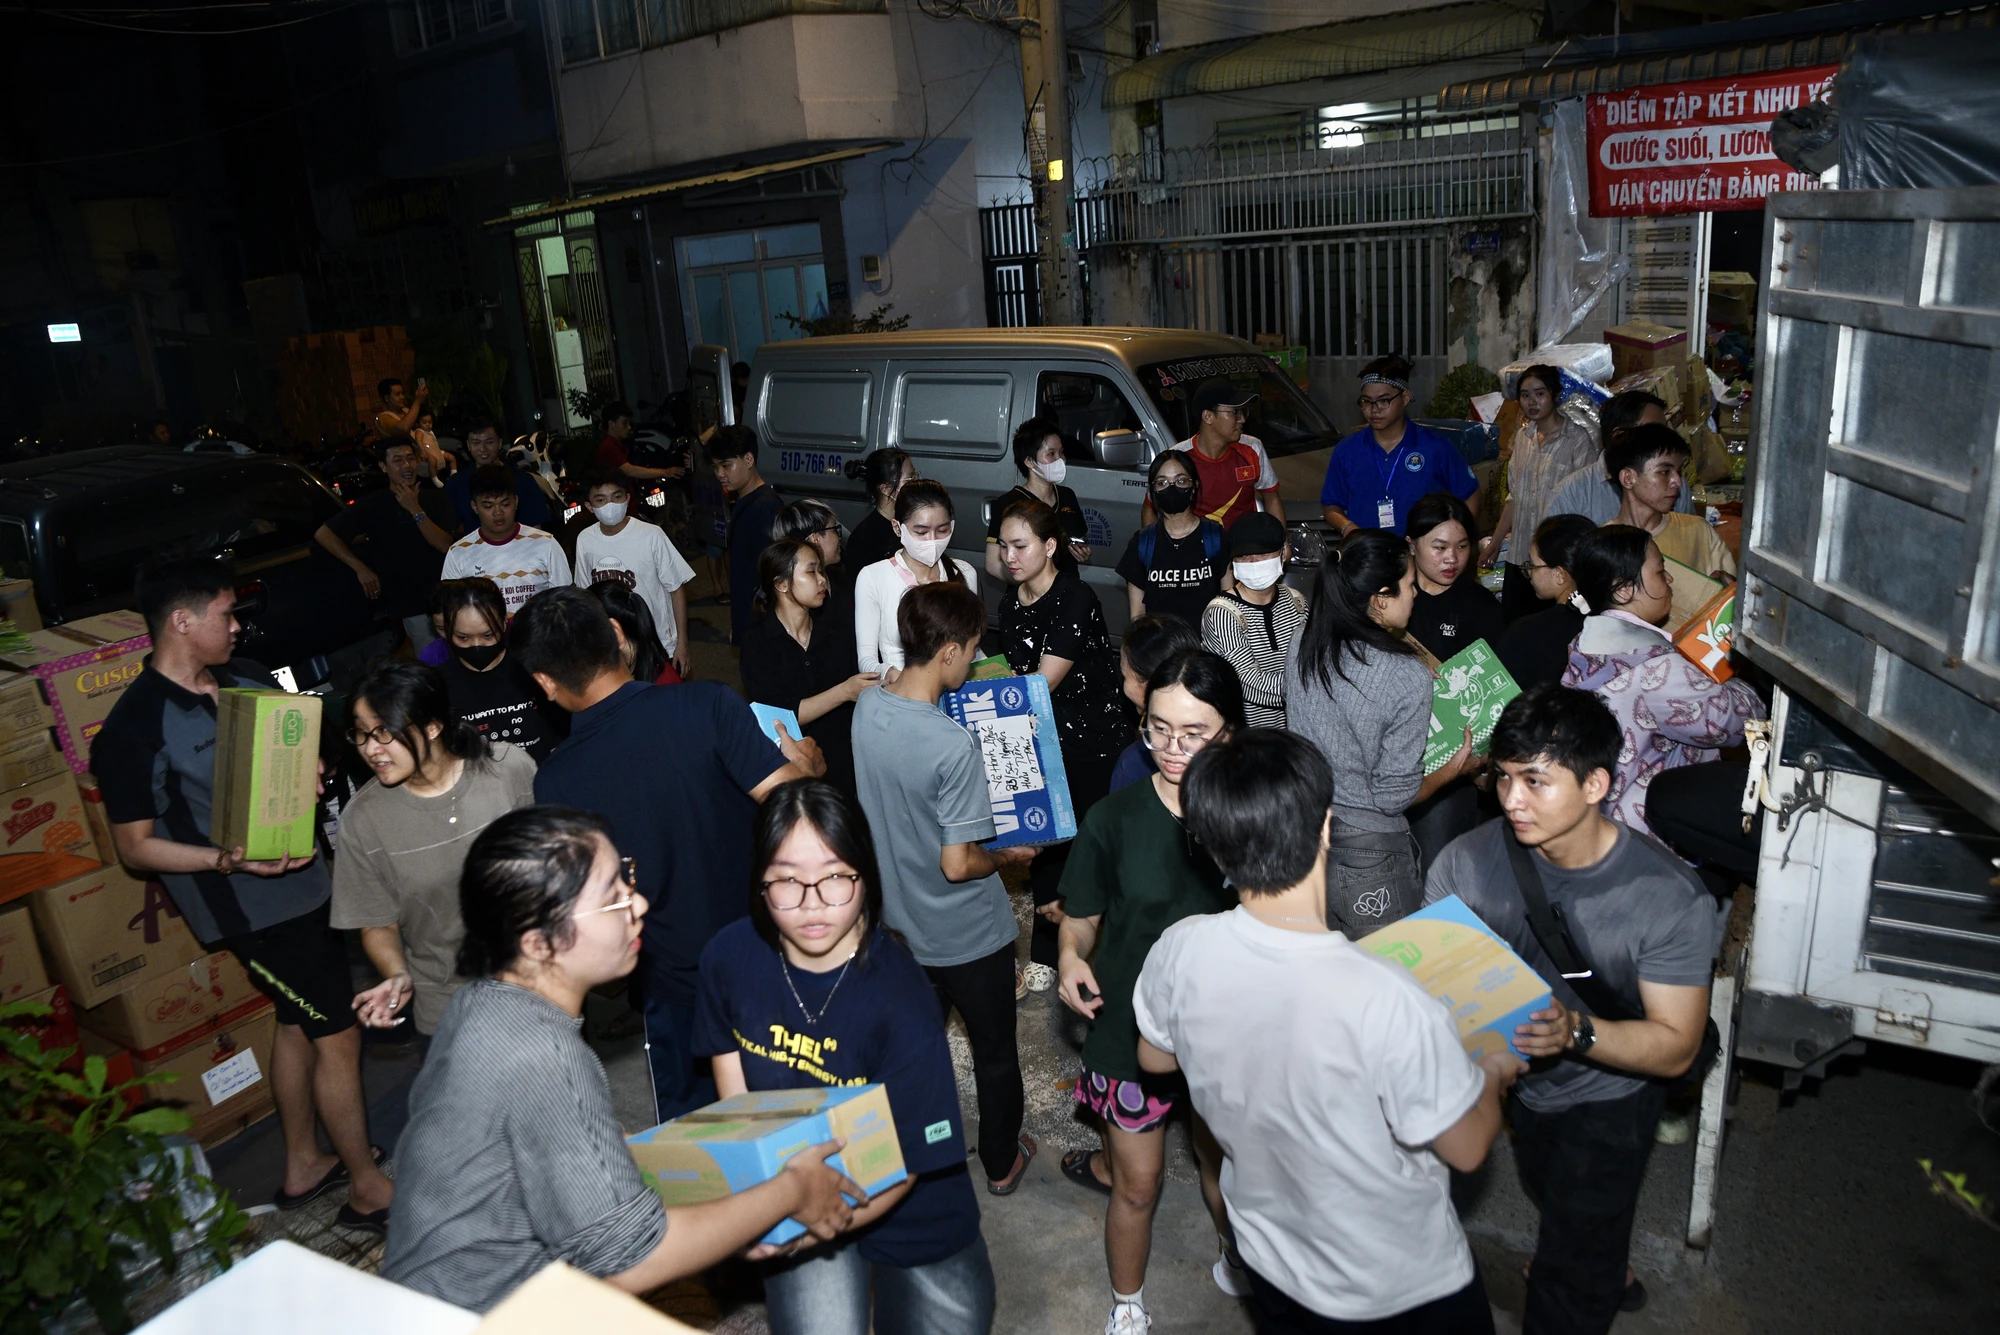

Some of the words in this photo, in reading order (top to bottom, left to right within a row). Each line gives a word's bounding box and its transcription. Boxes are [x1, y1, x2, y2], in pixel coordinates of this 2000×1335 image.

[1664, 91, 1702, 126] TẬP
[1708, 84, 1747, 117] KẾT
[1753, 85, 1800, 115] NHU
[1609, 135, 1659, 165] NƯỚC
[1664, 128, 1713, 161] SUỐI,
[1719, 128, 1776, 158] LƯƠN
[1609, 178, 1644, 210] VẬN
[1650, 168, 1722, 204] CHUYỂN
[1727, 166, 1780, 199] BẰNG
[1121, 479, 1150, 488] TERAC
[475, 708, 496, 719] WANT
[769, 1023, 825, 1067] THEL
[797, 1059, 838, 1086] ENERGY
